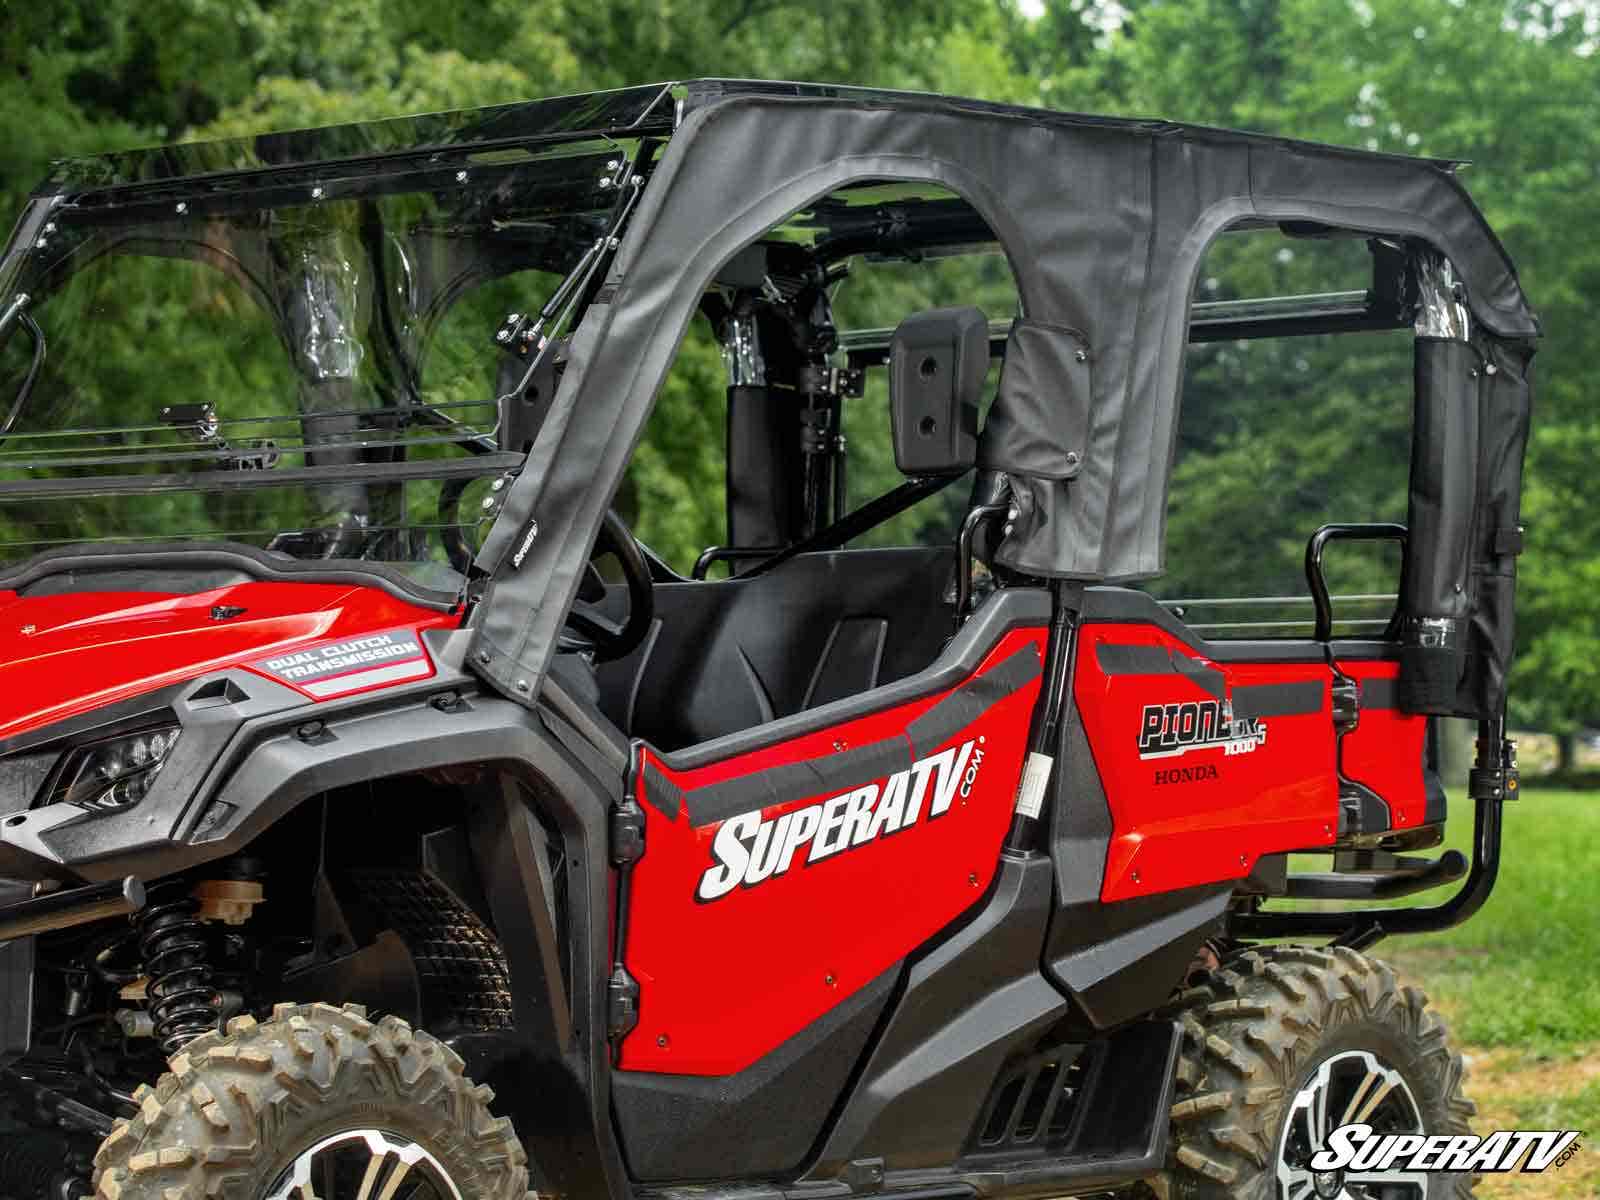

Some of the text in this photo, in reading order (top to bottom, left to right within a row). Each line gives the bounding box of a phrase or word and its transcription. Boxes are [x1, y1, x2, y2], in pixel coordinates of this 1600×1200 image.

[267, 635, 393, 670] DUAL CLUTCH
[280, 641, 420, 679] TRANSMISSION
[1154, 764, 1219, 785] HONDA
[696, 740, 975, 902] SUPERATV
